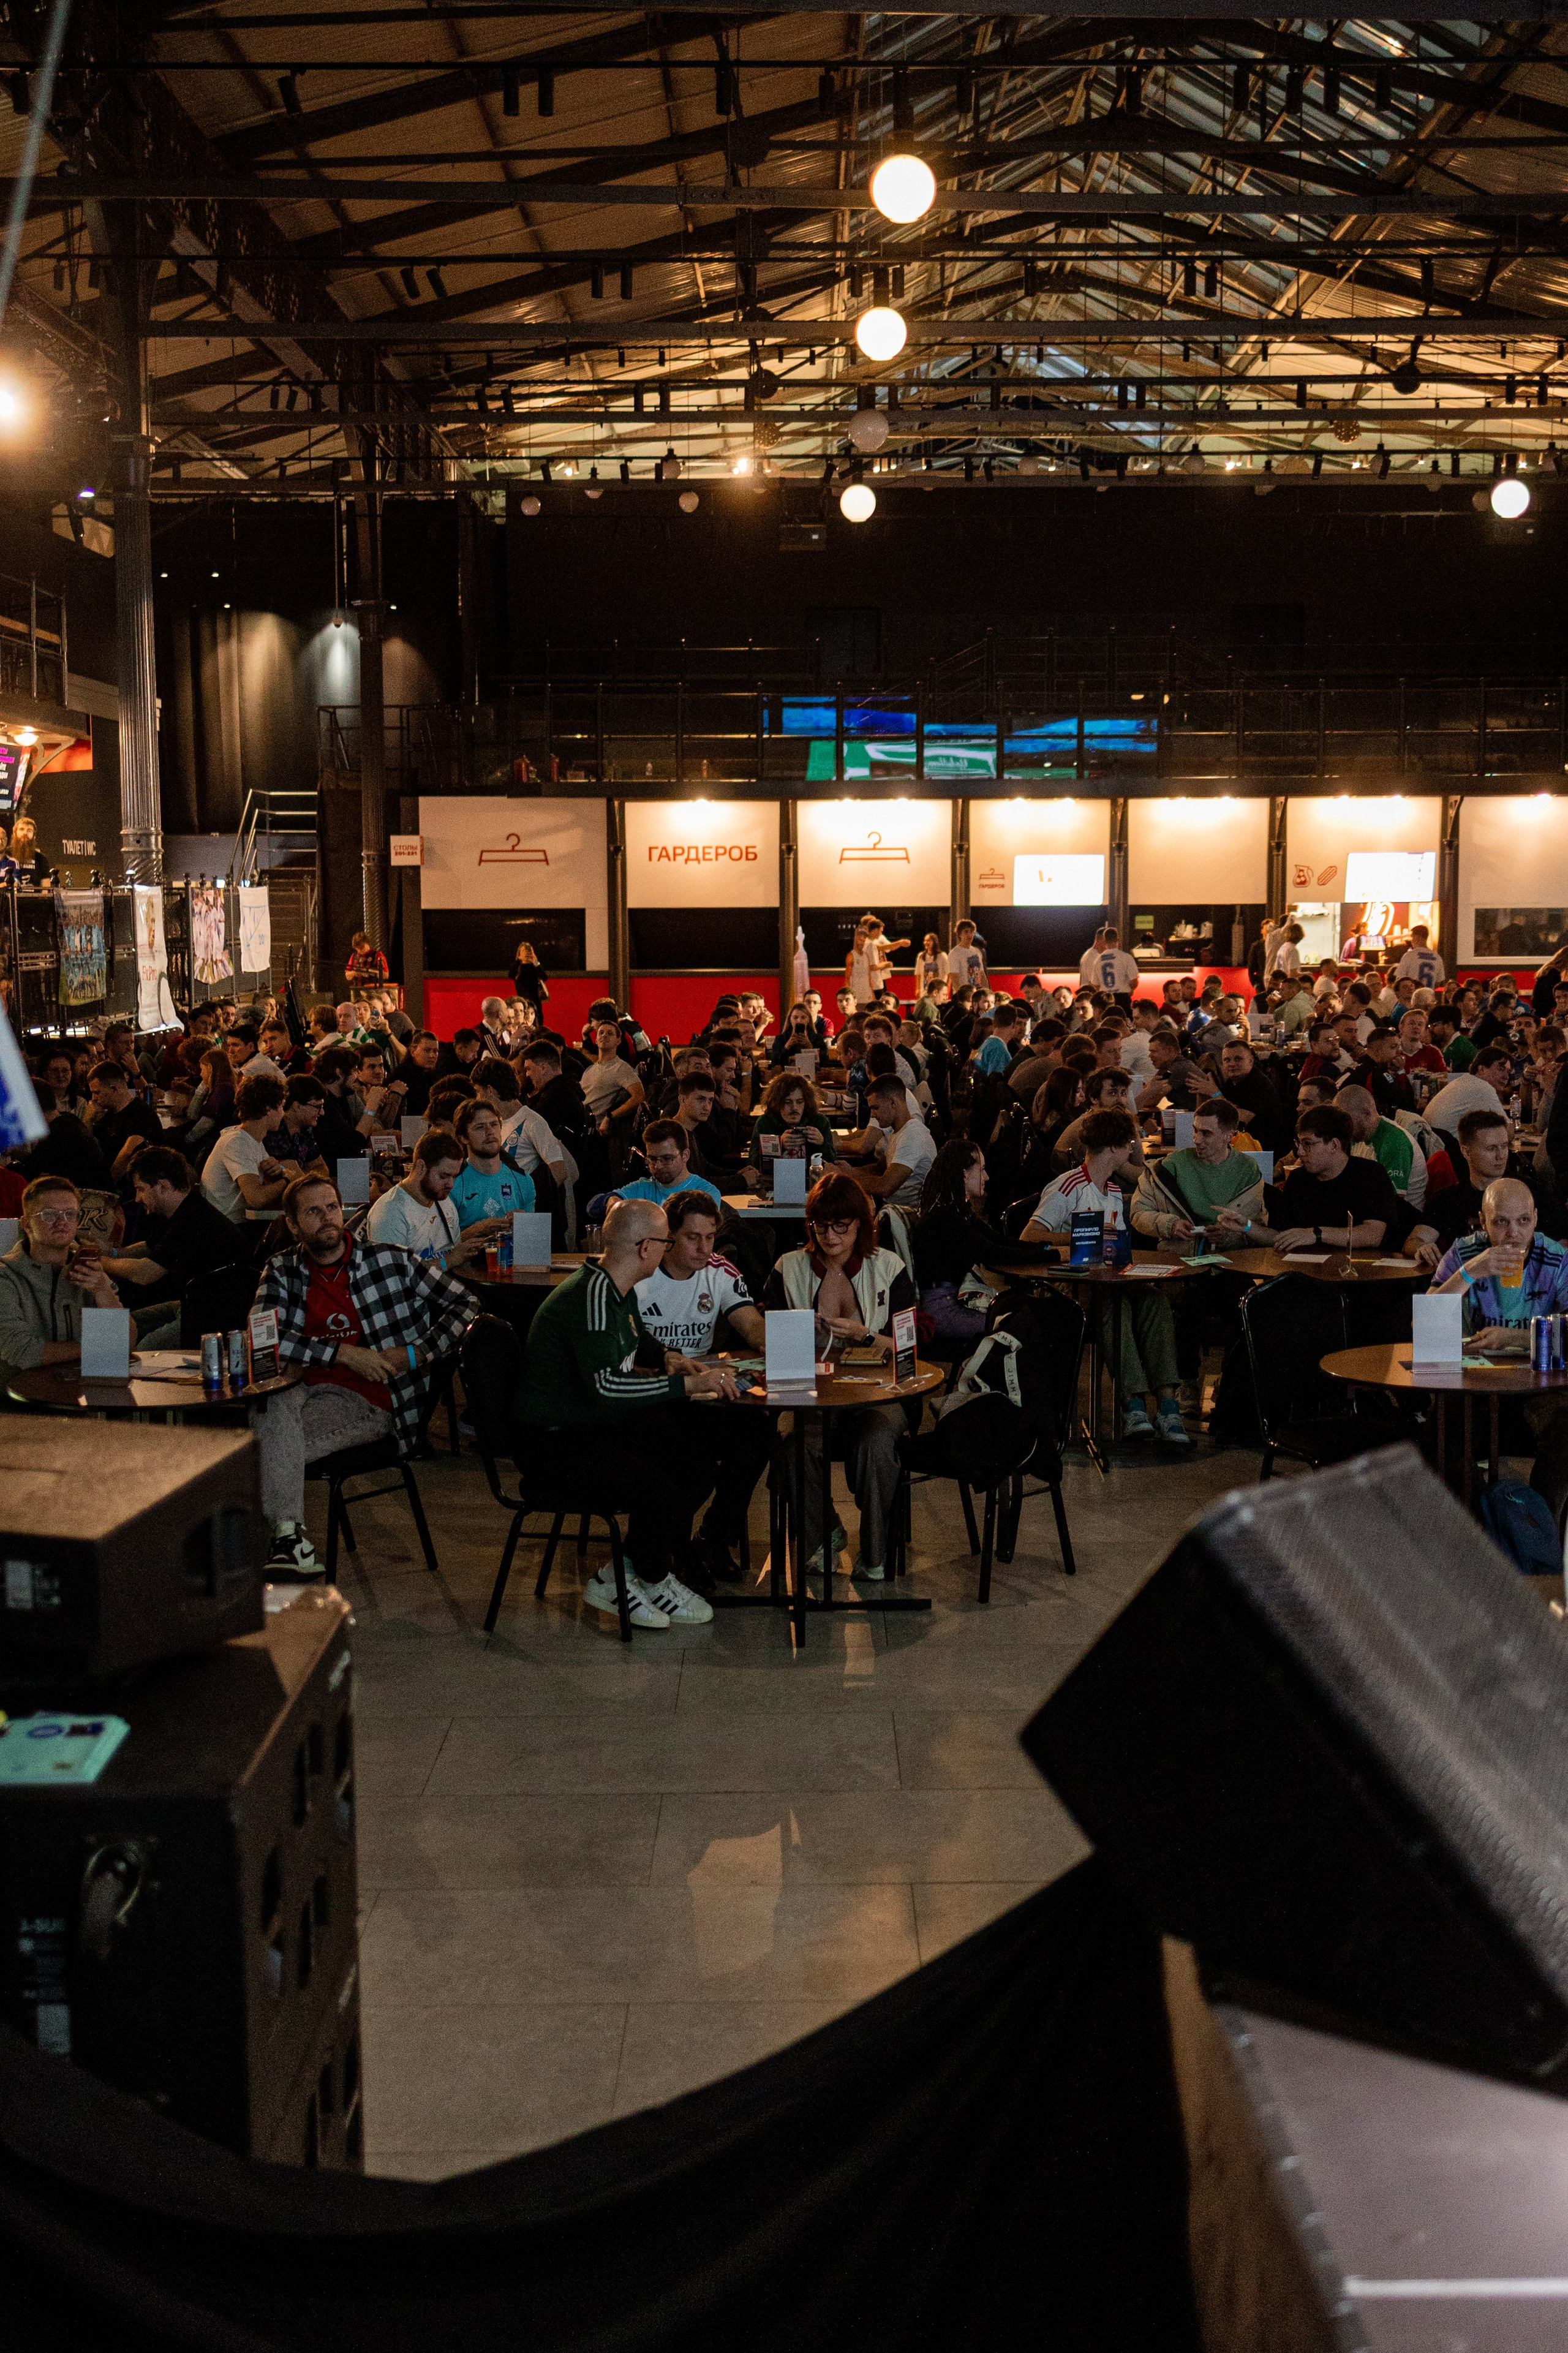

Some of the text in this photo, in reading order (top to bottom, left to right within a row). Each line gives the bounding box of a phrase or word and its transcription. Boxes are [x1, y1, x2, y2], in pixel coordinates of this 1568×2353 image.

[647, 845, 758, 864] ГАРДЕРОБ
[1101, 962, 1115, 989] 6
[668, 1338, 703, 1349] BETTER
